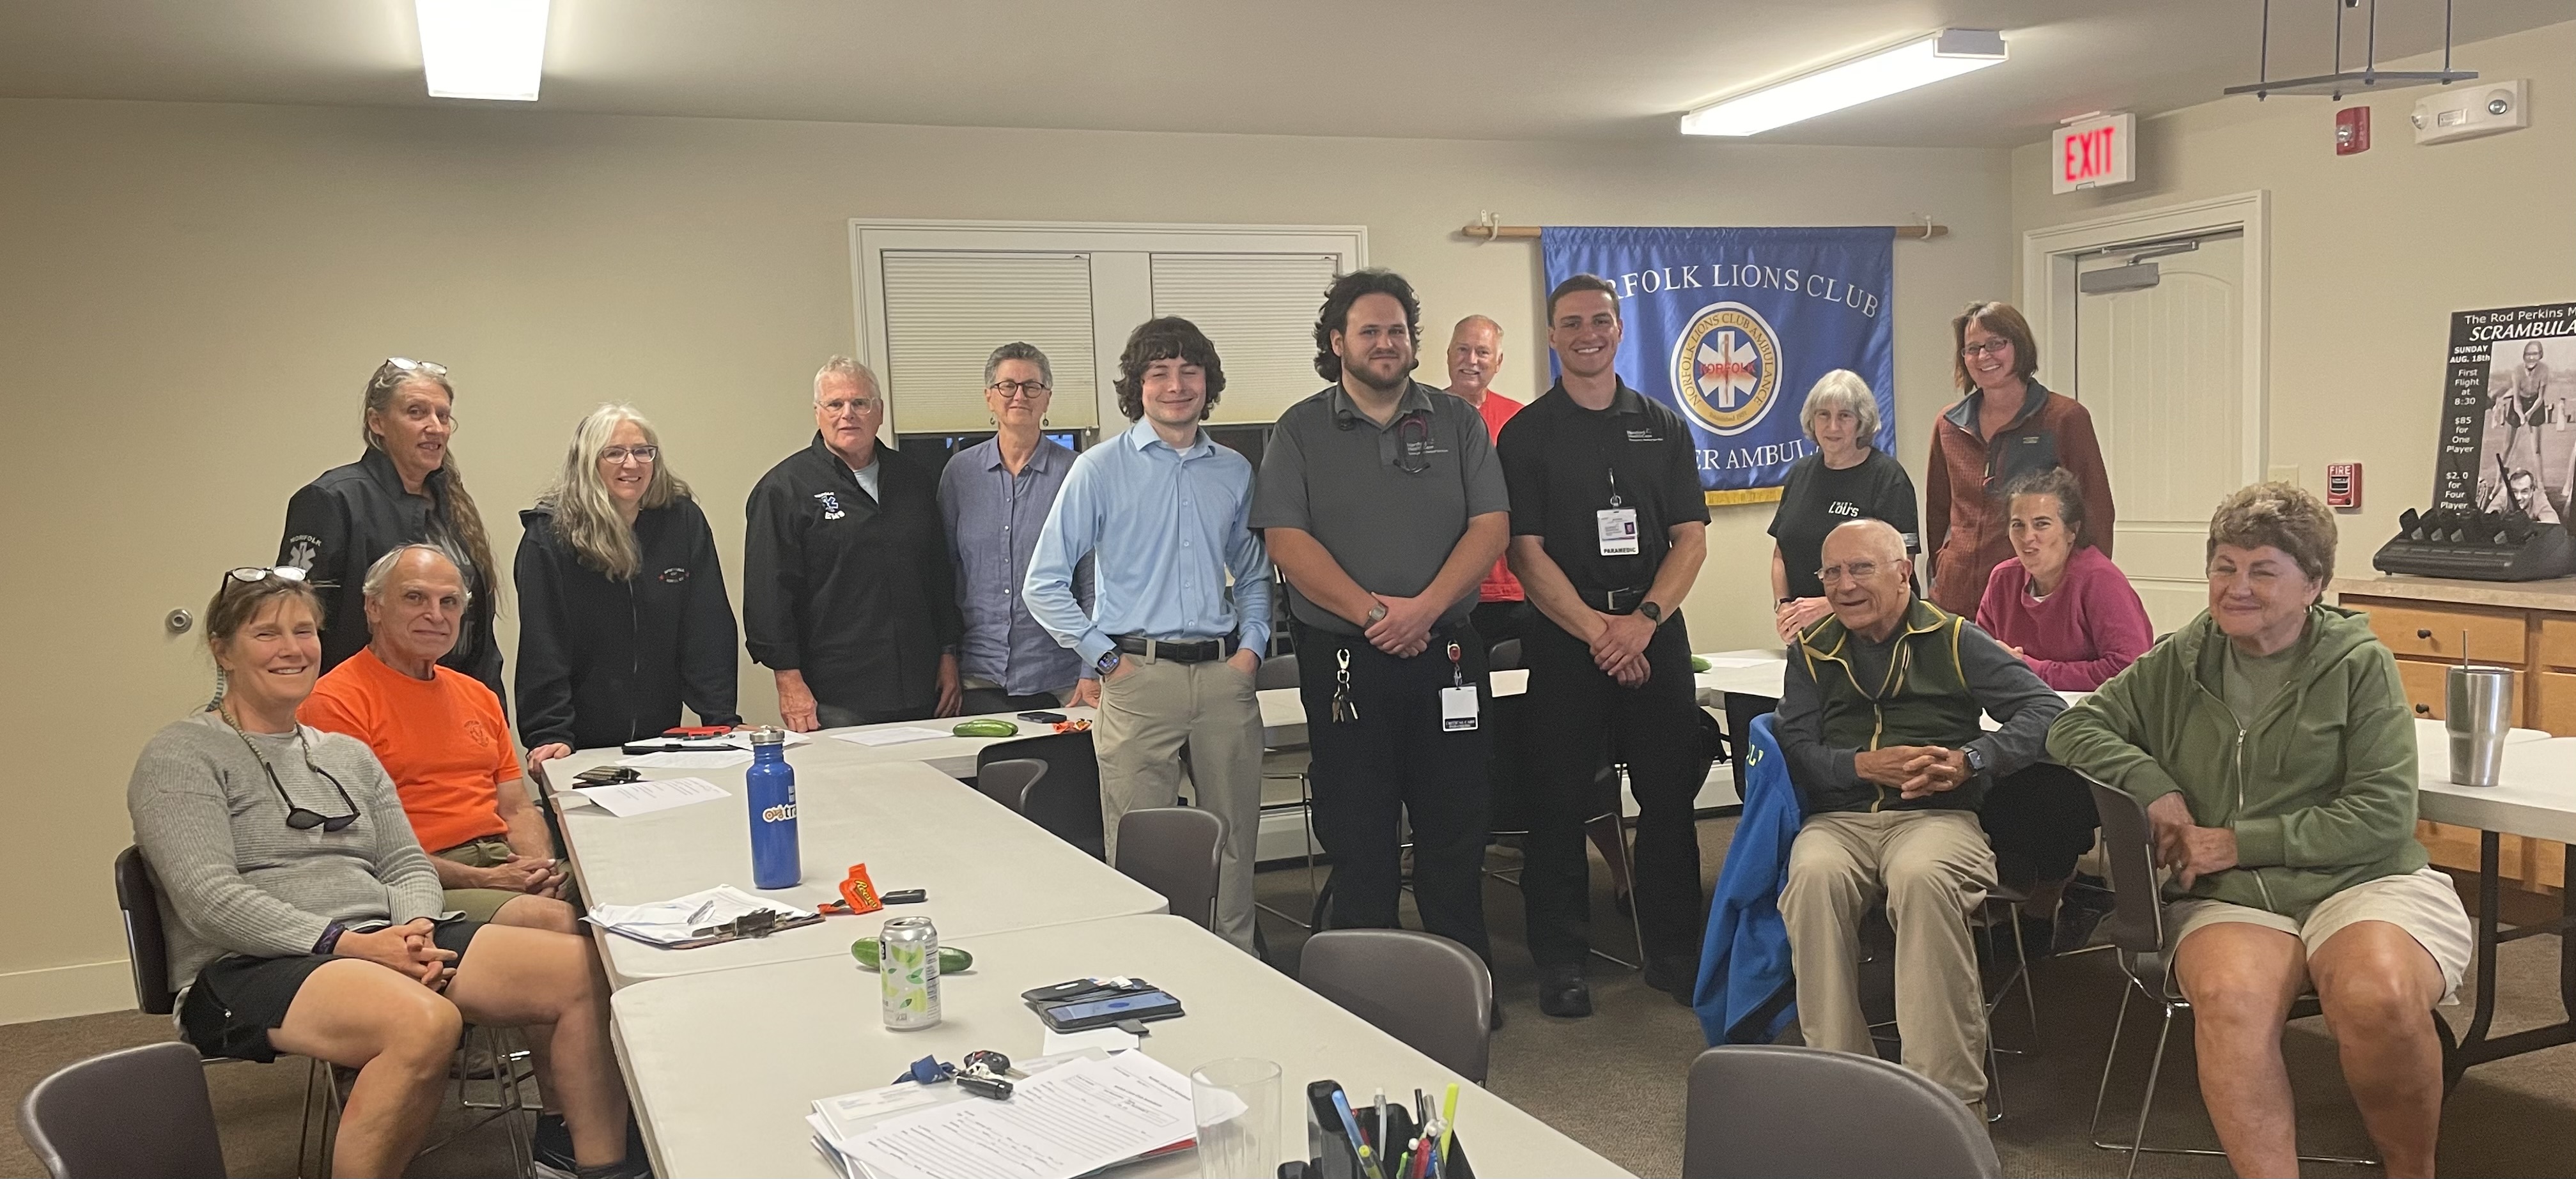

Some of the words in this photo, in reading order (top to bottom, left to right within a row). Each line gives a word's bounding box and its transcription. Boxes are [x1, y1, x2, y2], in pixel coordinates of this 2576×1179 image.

[2065, 127, 2115, 182] EXIT
[1712, 265, 1799, 291] LIONS
[1807, 275, 1879, 318] CLUB
[1722, 313, 1750, 328] CLUB
[2465, 314, 2487, 324] The
[2491, 312, 2513, 322] Rod
[2518, 309, 2563, 320] Perkins
[1691, 315, 1719, 343] LIONS
[2469, 319, 2576, 341] SCRAMBULA
[2455, 345, 2488, 354] SUNDAY
[1700, 362, 1756, 375] NORFOLK
[1750, 327, 1774, 406] AMBULANCE
[1682, 344, 1701, 406] NORFOLK
[2455, 378, 2479, 387] Flight
[2455, 417, 2471, 425] $85
[2446, 445, 2474, 454] Player
[2330, 466, 2351, 475] FIRE
